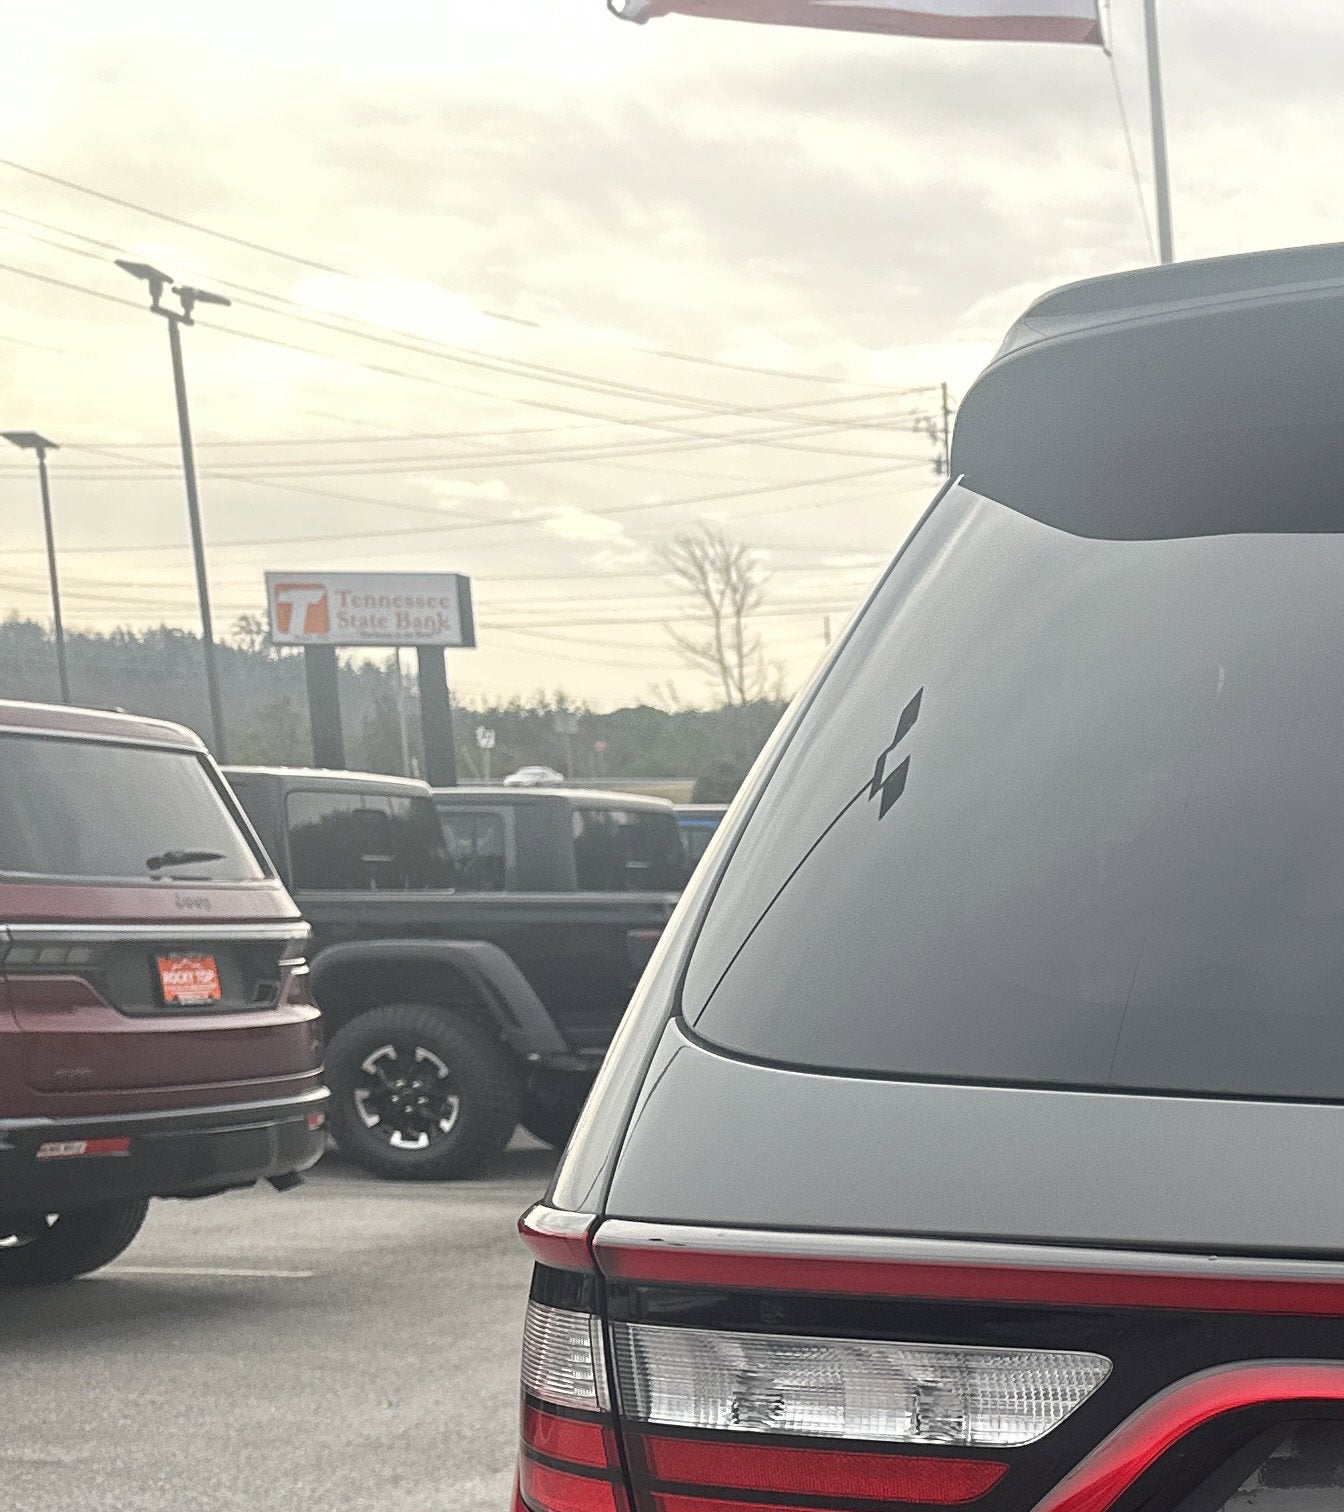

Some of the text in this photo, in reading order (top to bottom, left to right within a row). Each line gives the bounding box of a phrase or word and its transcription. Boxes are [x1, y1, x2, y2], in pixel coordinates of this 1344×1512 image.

[334, 588, 450, 609] Tennessee
[336, 610, 451, 632] State Bank
